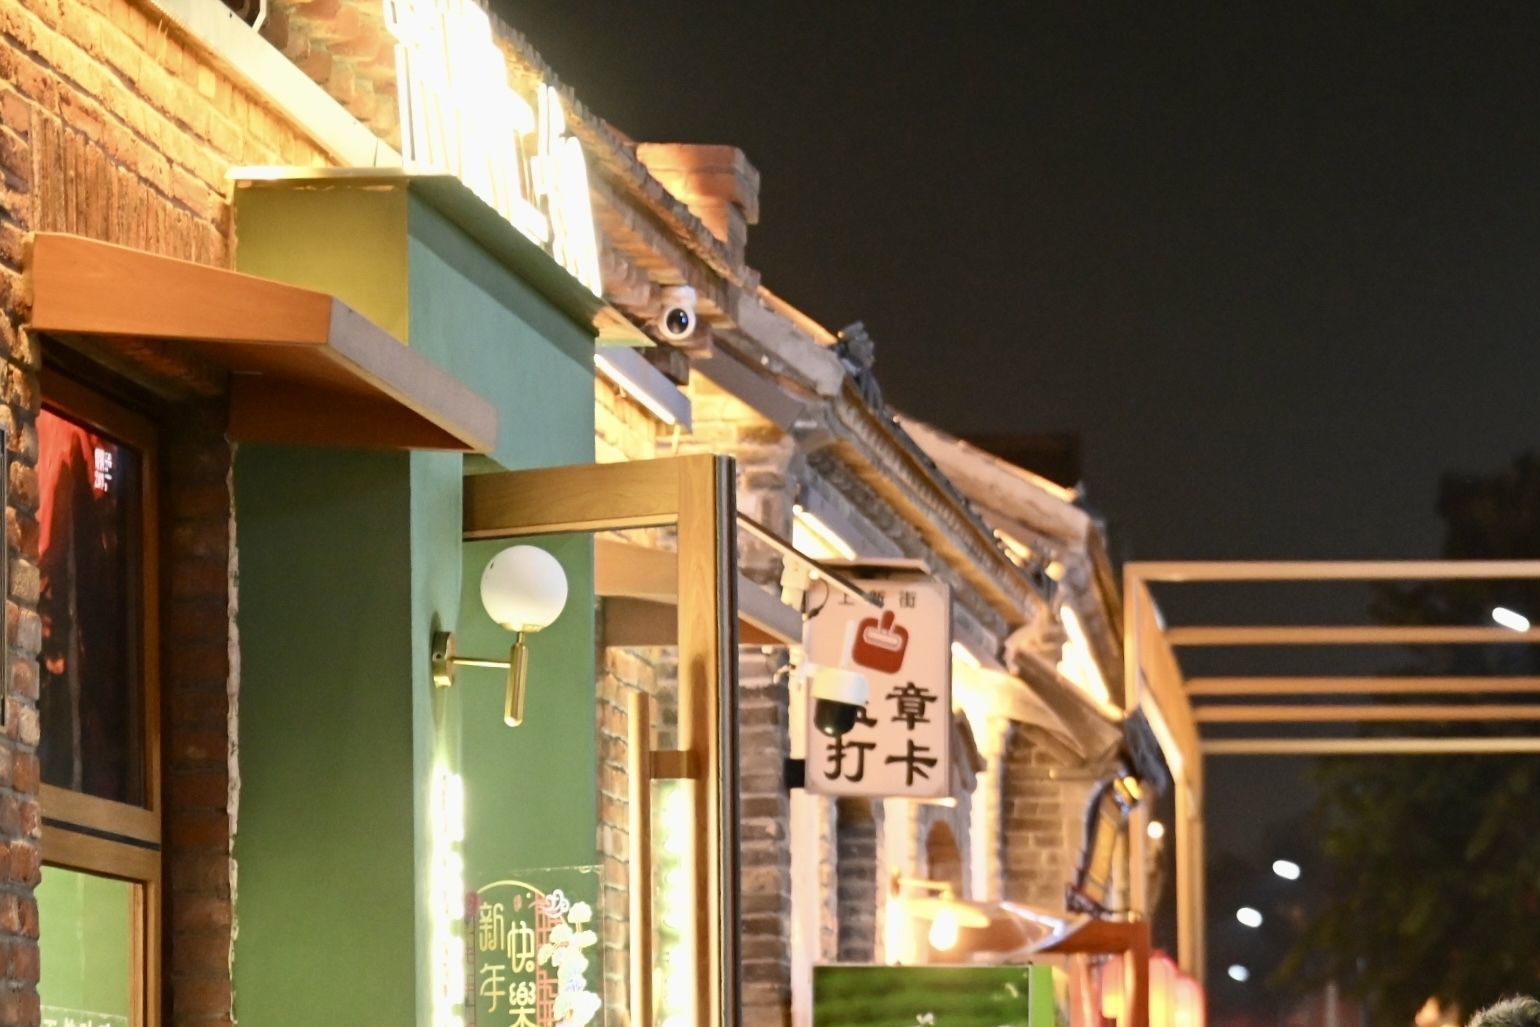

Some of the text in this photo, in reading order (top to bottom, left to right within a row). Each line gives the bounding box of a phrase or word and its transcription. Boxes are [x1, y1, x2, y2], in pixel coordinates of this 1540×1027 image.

[853, 681, 938, 731] 章
[823, 739, 938, 787] 打卡
[479, 901, 506, 1014] 新年
